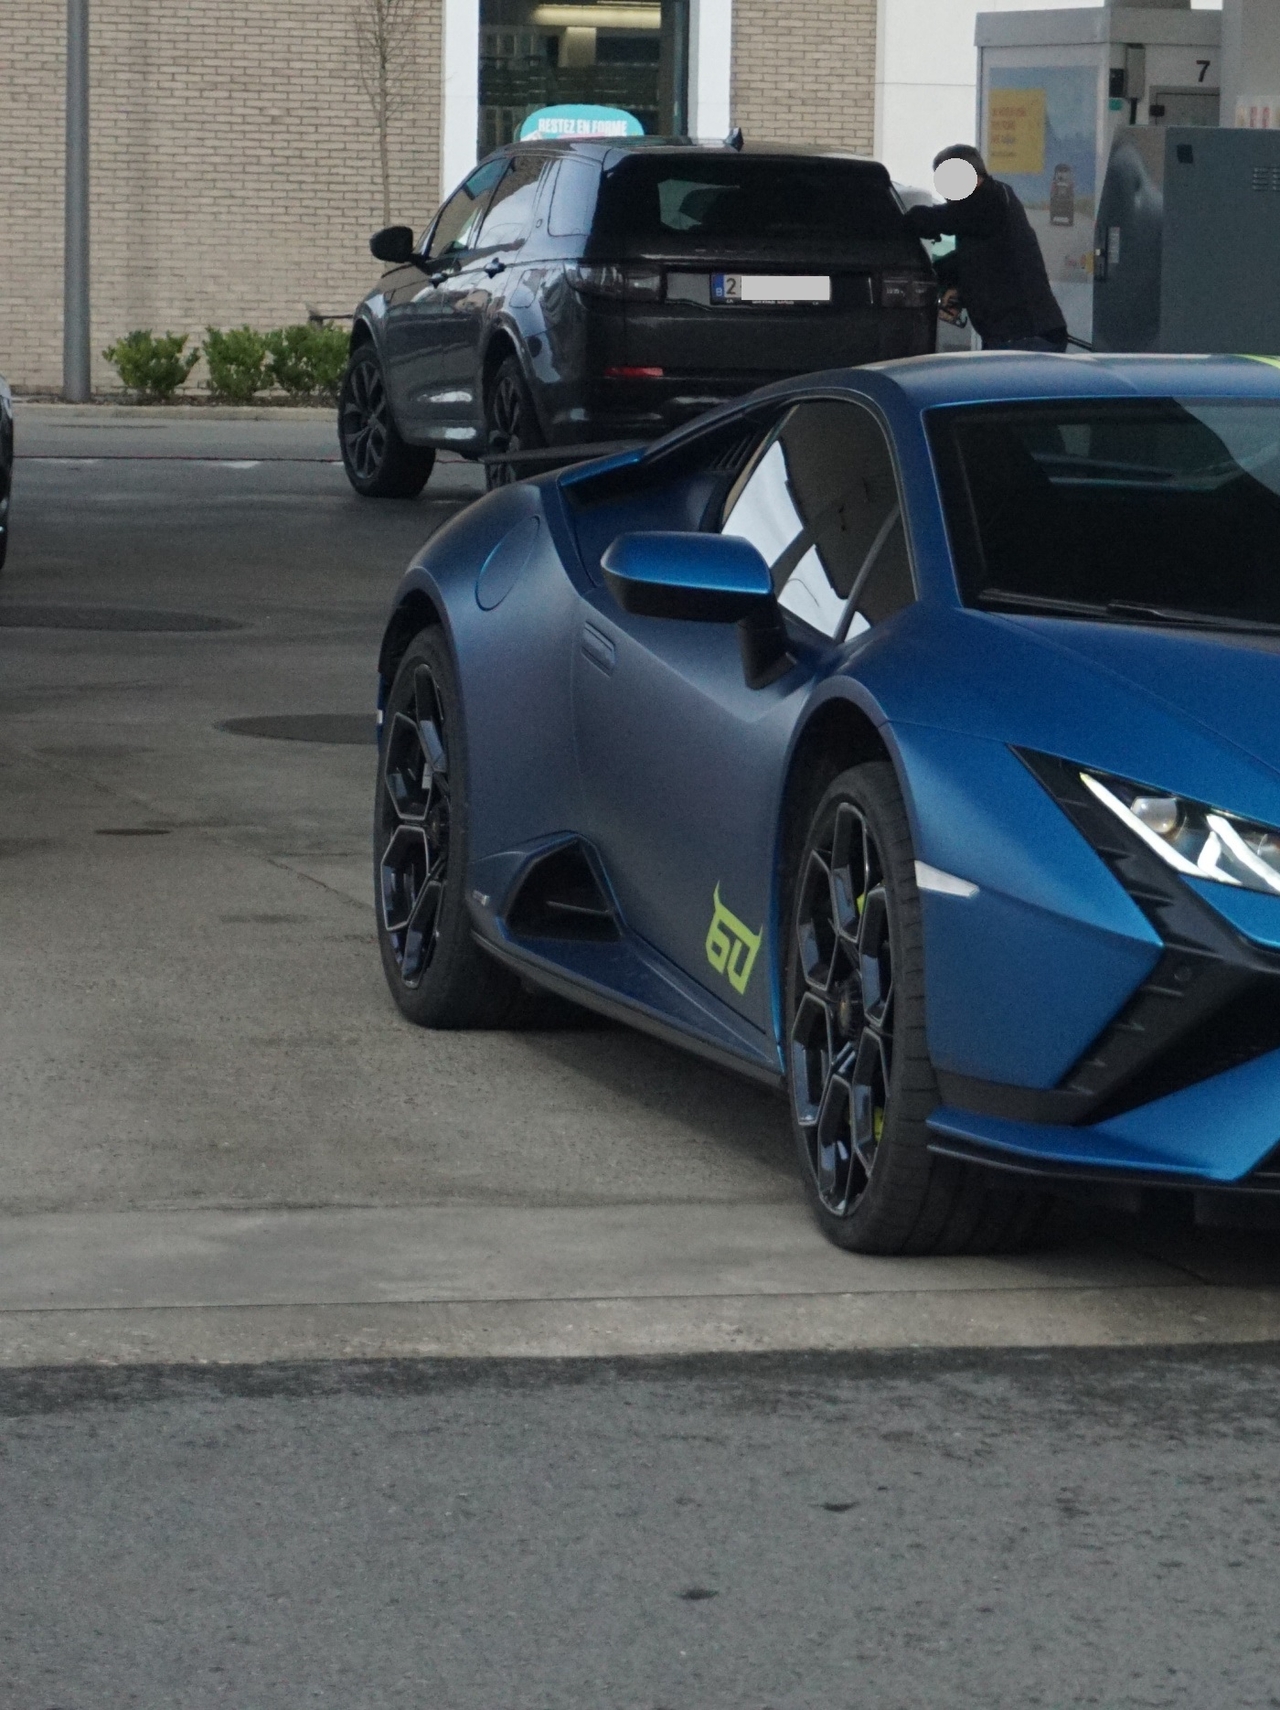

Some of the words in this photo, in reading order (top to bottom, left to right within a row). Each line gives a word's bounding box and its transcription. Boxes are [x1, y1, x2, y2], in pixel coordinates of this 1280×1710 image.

[1196, 60, 1211, 83] 7
[538, 118, 575, 134] RESTEZ
[577, 119, 591, 135] EN
